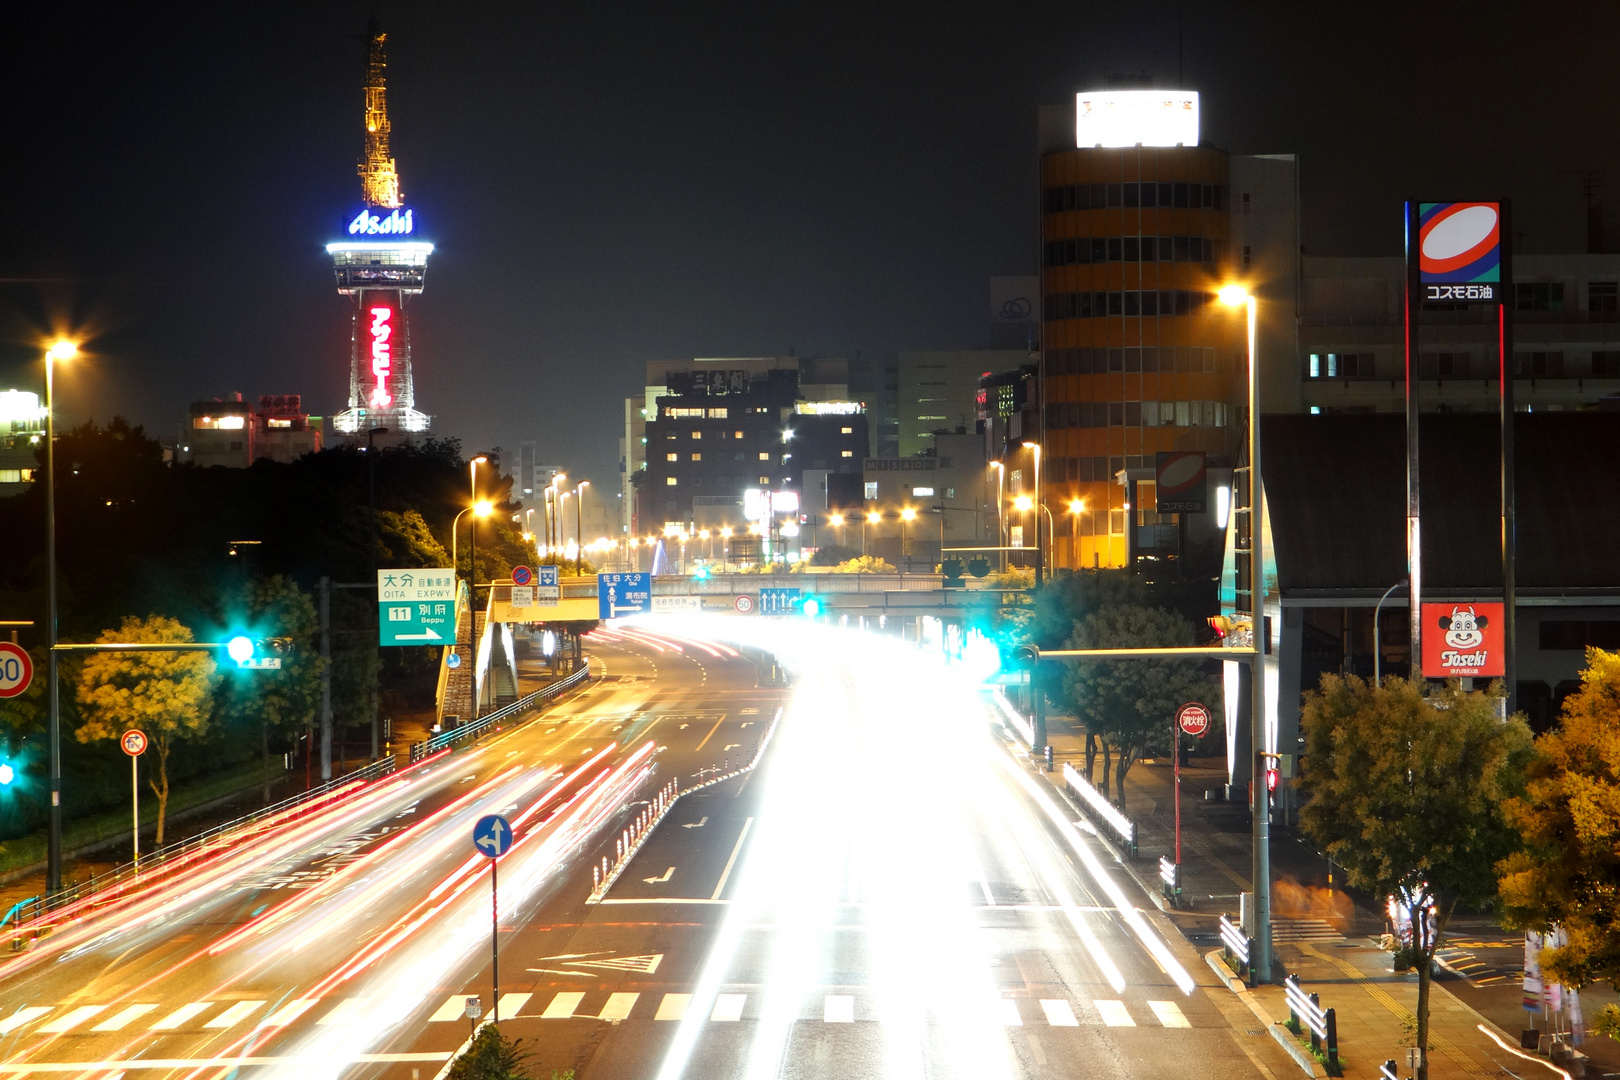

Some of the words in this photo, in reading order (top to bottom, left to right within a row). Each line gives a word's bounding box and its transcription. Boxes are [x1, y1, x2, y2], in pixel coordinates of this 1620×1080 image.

[348, 209, 413, 234] Asahi
[1427, 285, 1493, 299] コスモ石油
[371, 307, 391, 406] アサヒビール
[384, 574, 413, 587] 大分
[603, 574, 620, 582] 佐伯
[624, 574, 641, 582] 大分
[384, 590, 406, 598] OITA
[419, 604, 446, 616] 別府
[738, 600, 750, 609] 50
[393, 609, 407, 620] 11
[1441, 650, 1487, 667] Toseki
[0, 658, 19, 681] 0
[1182, 715, 1205, 726] 消火栓
